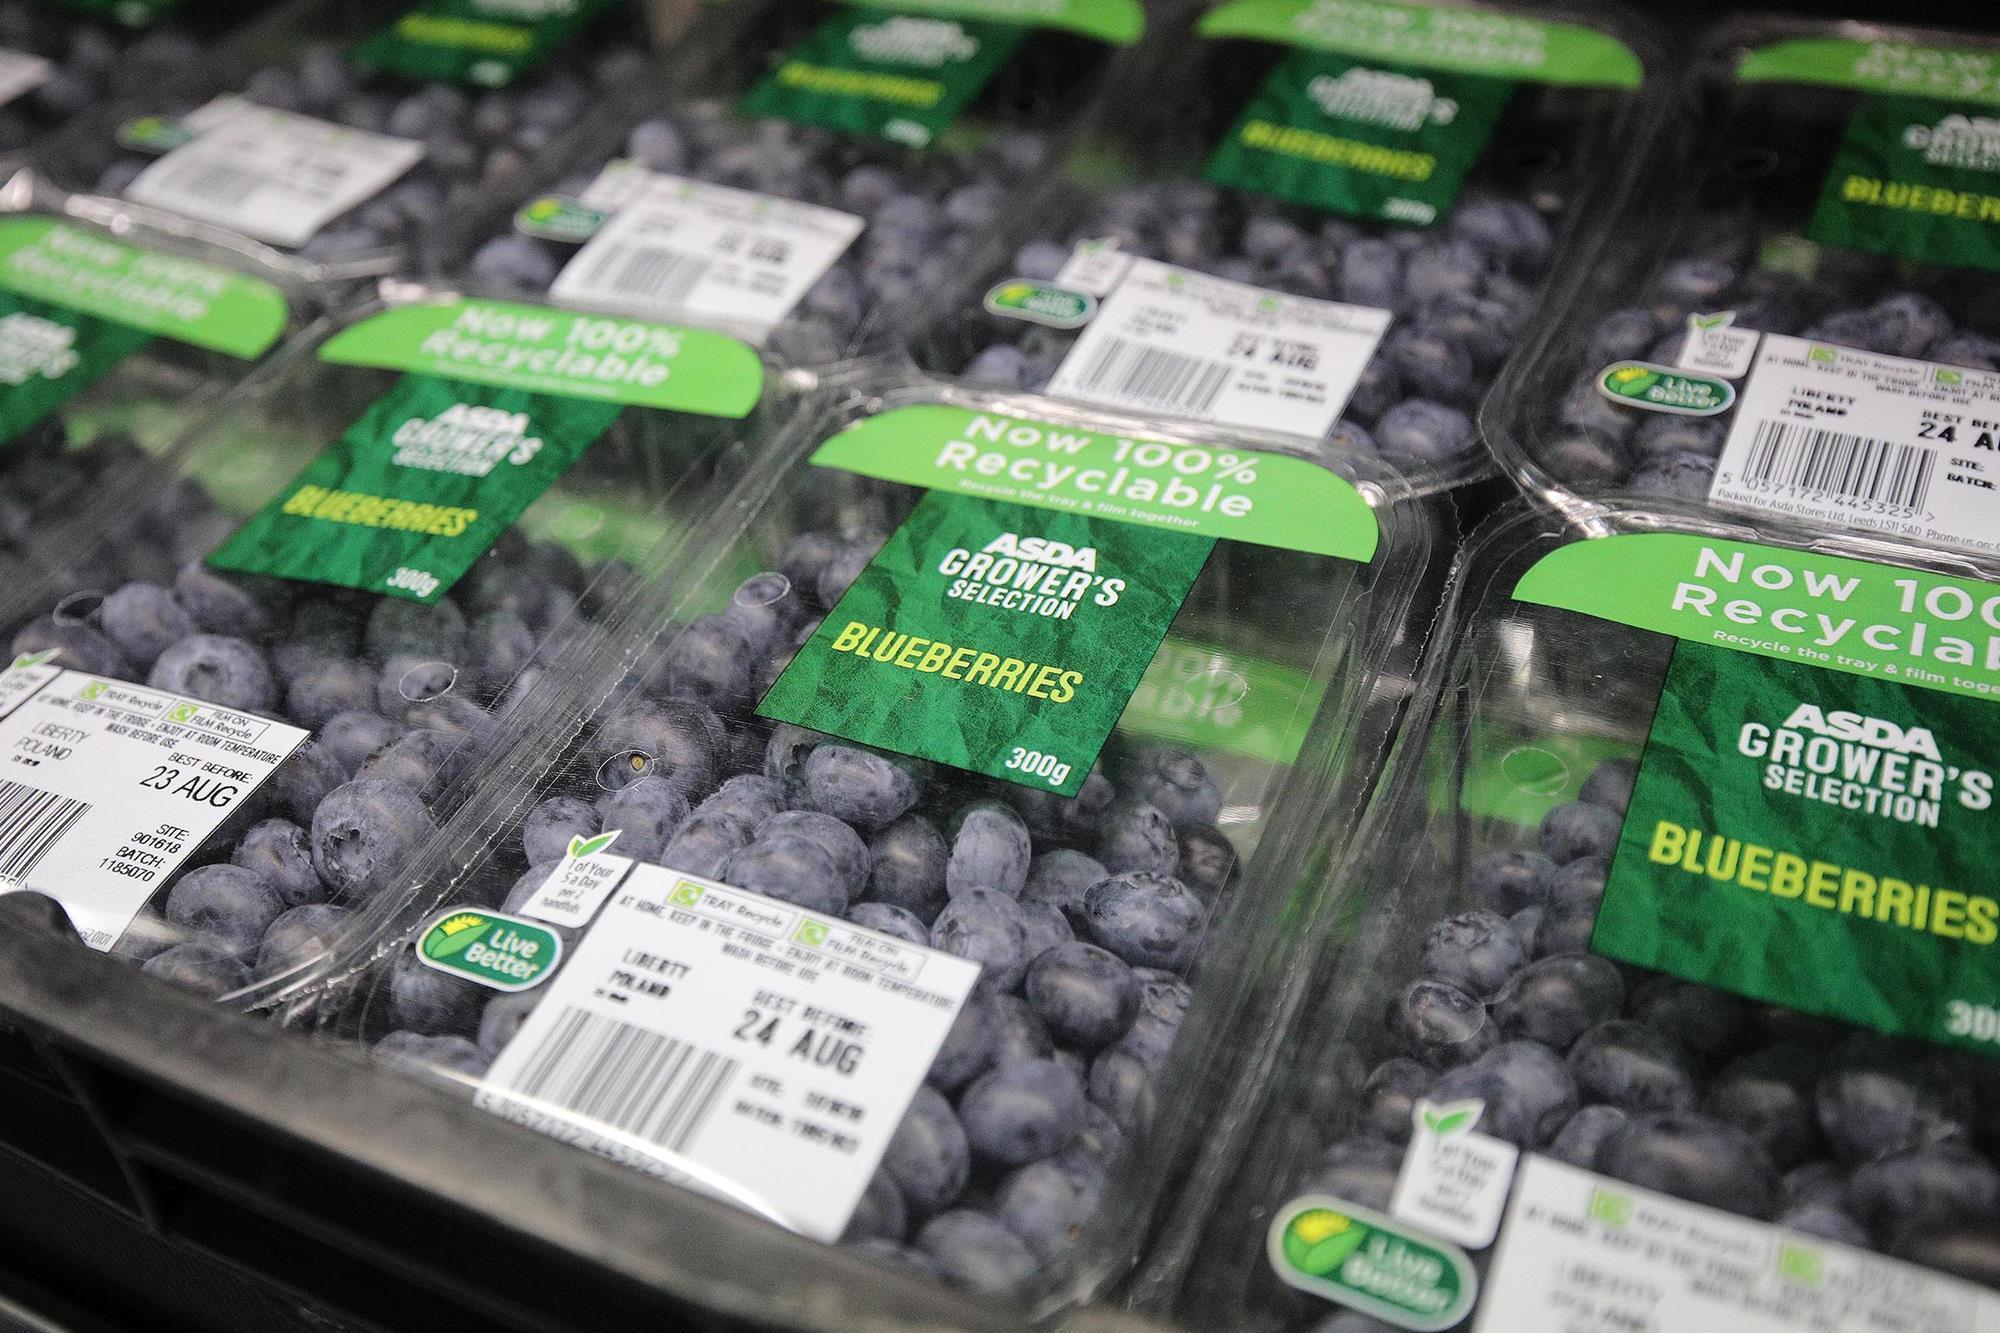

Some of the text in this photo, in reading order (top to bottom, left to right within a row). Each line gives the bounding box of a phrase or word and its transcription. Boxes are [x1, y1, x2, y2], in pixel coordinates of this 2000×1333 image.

[964, 415, 1259, 485] Now 100%
[1918, 421, 2000, 451] 24 A
[935, 440, 1254, 517] Recyclable
[1720, 471, 1913, 519] 5 057172 445325
[1129, 508, 1200, 529] together
[1718, 488, 1751, 502] Packed
[1754, 494, 1768, 505] for
[1770, 497, 1793, 512] Asda
[1796, 503, 1826, 519] Stores
[1849, 512, 1878, 528] Leeds
[1926, 529, 1959, 543] Phone
[982, 532, 1098, 572] ASDA
[386, 566, 440, 598] 300g
[938, 547, 1126, 606] GROWER'S
[1694, 546, 1862, 602] Now
[947, 579, 1077, 620] SELECTION
[831, 621, 1084, 704] BLUEBERRIES
[1713, 630, 1791, 654] Recycle
[1797, 646, 1830, 662] the
[1837, 654, 1878, 673] tray
[1884, 664, 1898, 674] &
[1905, 667, 1946, 684] film
[14, 736, 73, 761] POLAND
[32, 721, 91, 744] LIBERTY
[214, 723, 253, 740] Recycle
[1782, 702, 1943, 761] ASDA
[168, 752, 202, 769] BEST
[222, 739, 283, 765] TEMPERATURE
[1005, 747, 1072, 787] 300g
[1738, 721, 1995, 811] GROWER'S
[139, 766, 239, 808] 23 AUG
[1763, 764, 1941, 829] SELECTION
[131, 832, 182, 854] 901618
[156, 824, 190, 842] SITE:
[99, 857, 156, 882] 1185070
[116, 846, 166, 869] BATCH:
[575, 861, 589, 873] of
[588, 864, 615, 879] Your
[578, 876, 602, 891] Day
[1649, 820, 2000, 945] BLUEBERRIES
[465, 941, 541, 979] Better
[490, 927, 540, 959] Live
[621, 948, 692, 980] LIBERTY
[1946, 1000, 2000, 1044] 30
[732, 1009, 865, 1077] 24 AUG
